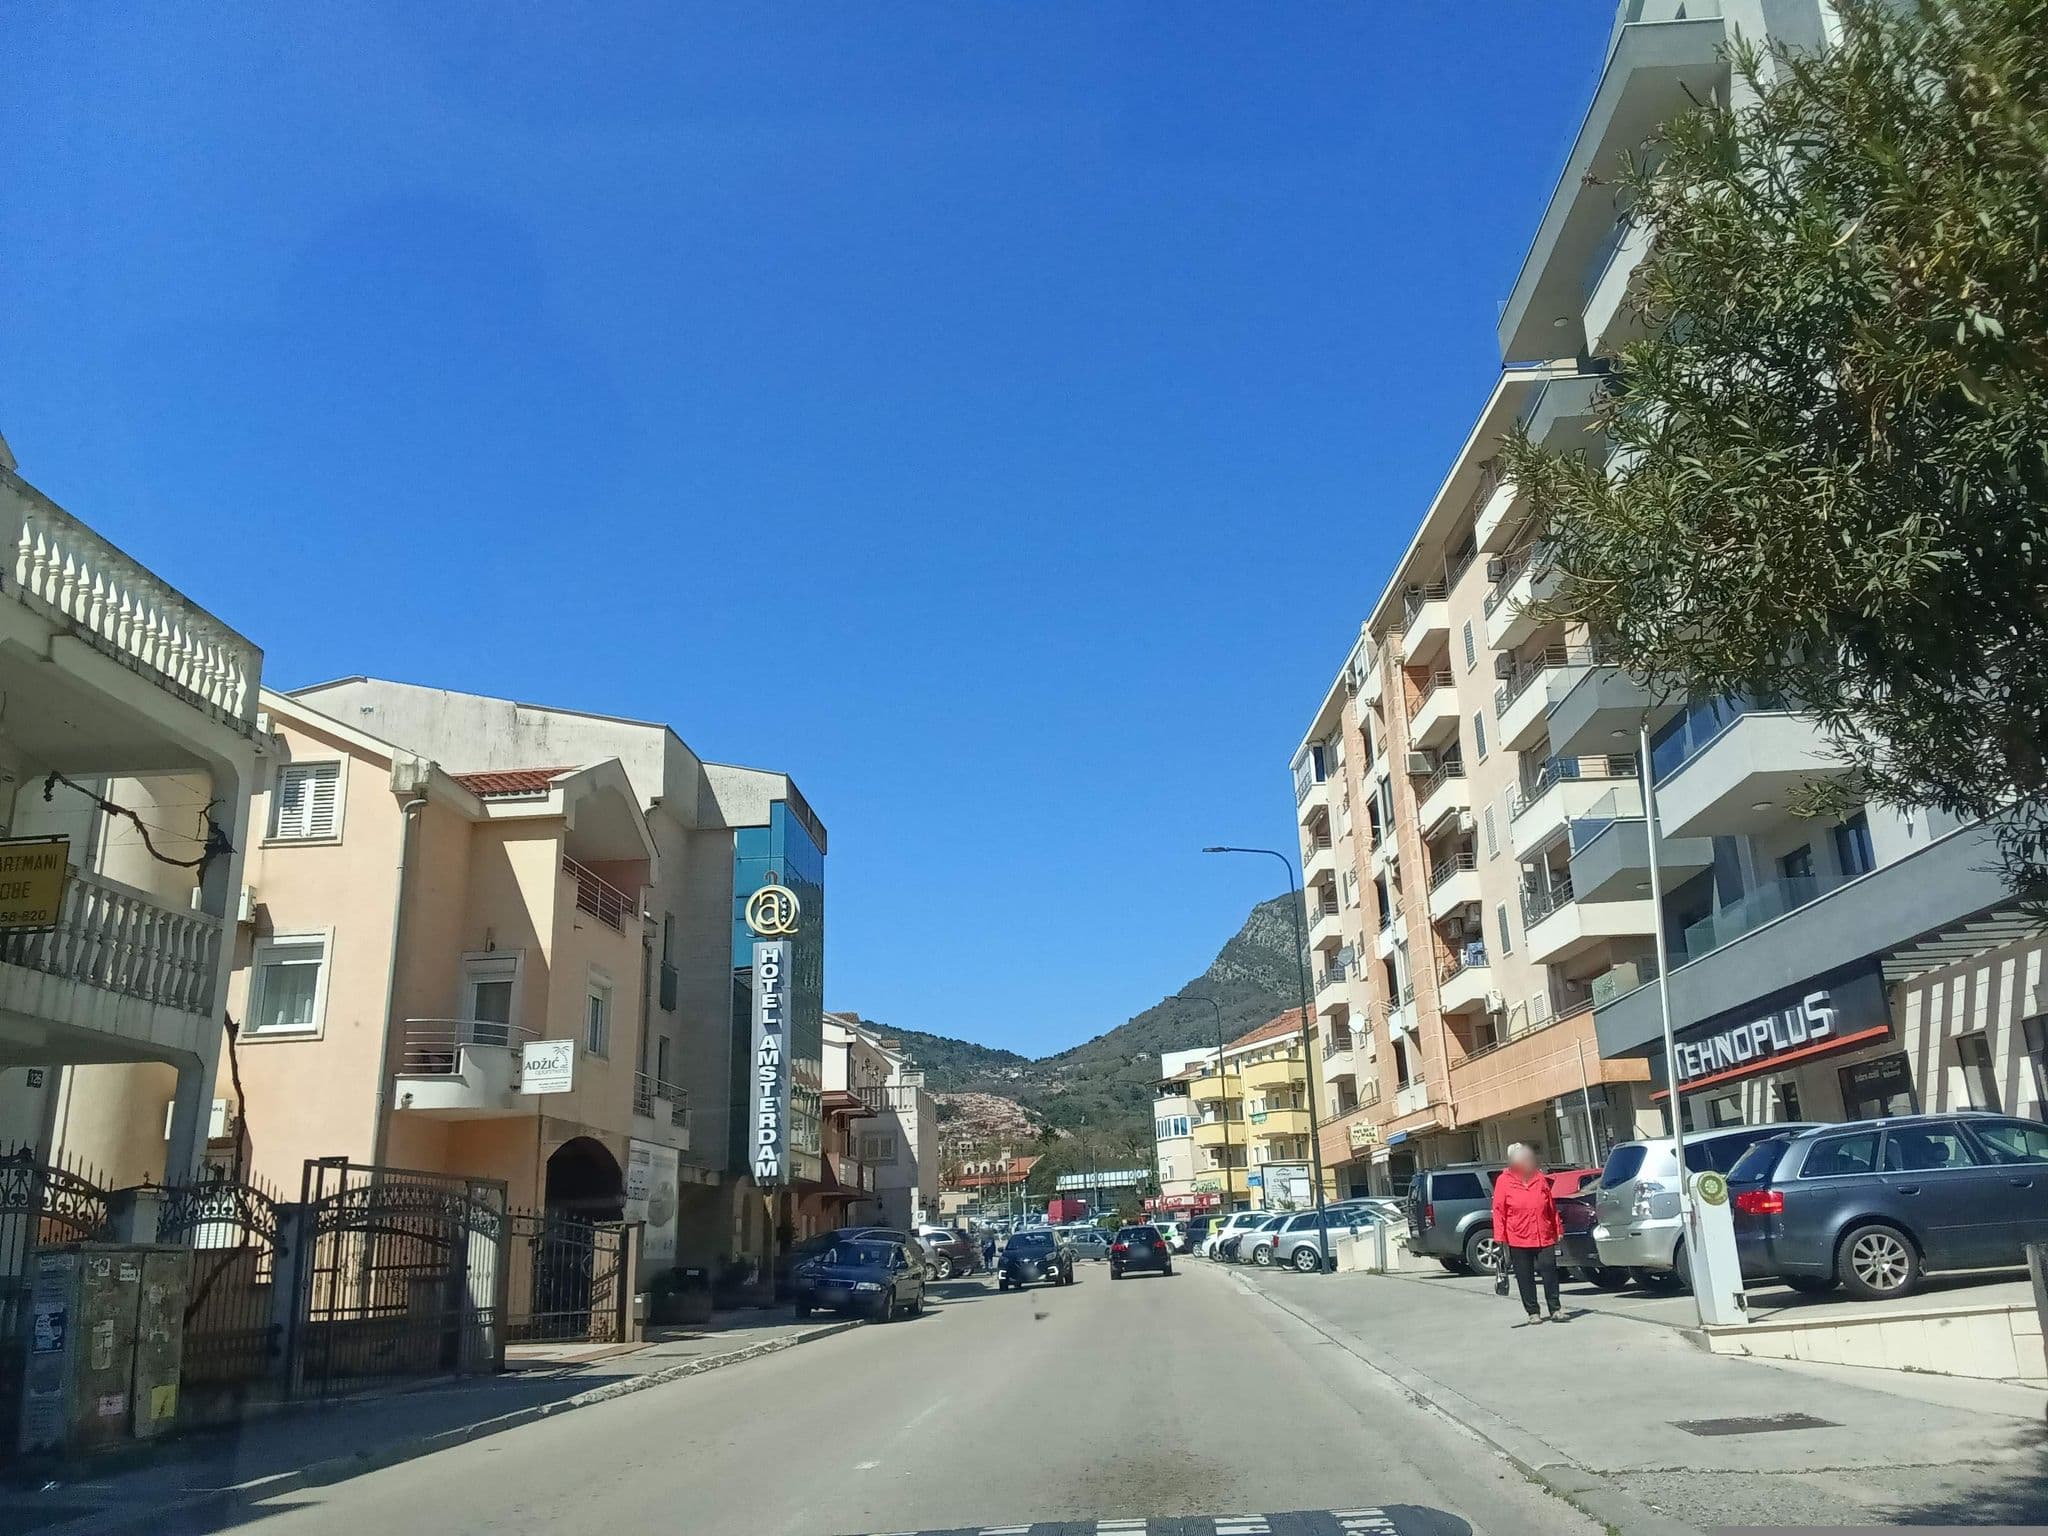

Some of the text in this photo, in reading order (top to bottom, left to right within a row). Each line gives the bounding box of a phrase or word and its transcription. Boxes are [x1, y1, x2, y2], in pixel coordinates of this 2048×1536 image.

[524, 1056, 560, 1071] ADŽIĆ
[755, 948, 779, 1177] HOTEL AMSTERDAM
[1674, 990, 1837, 1080] TEHNOPLUS
